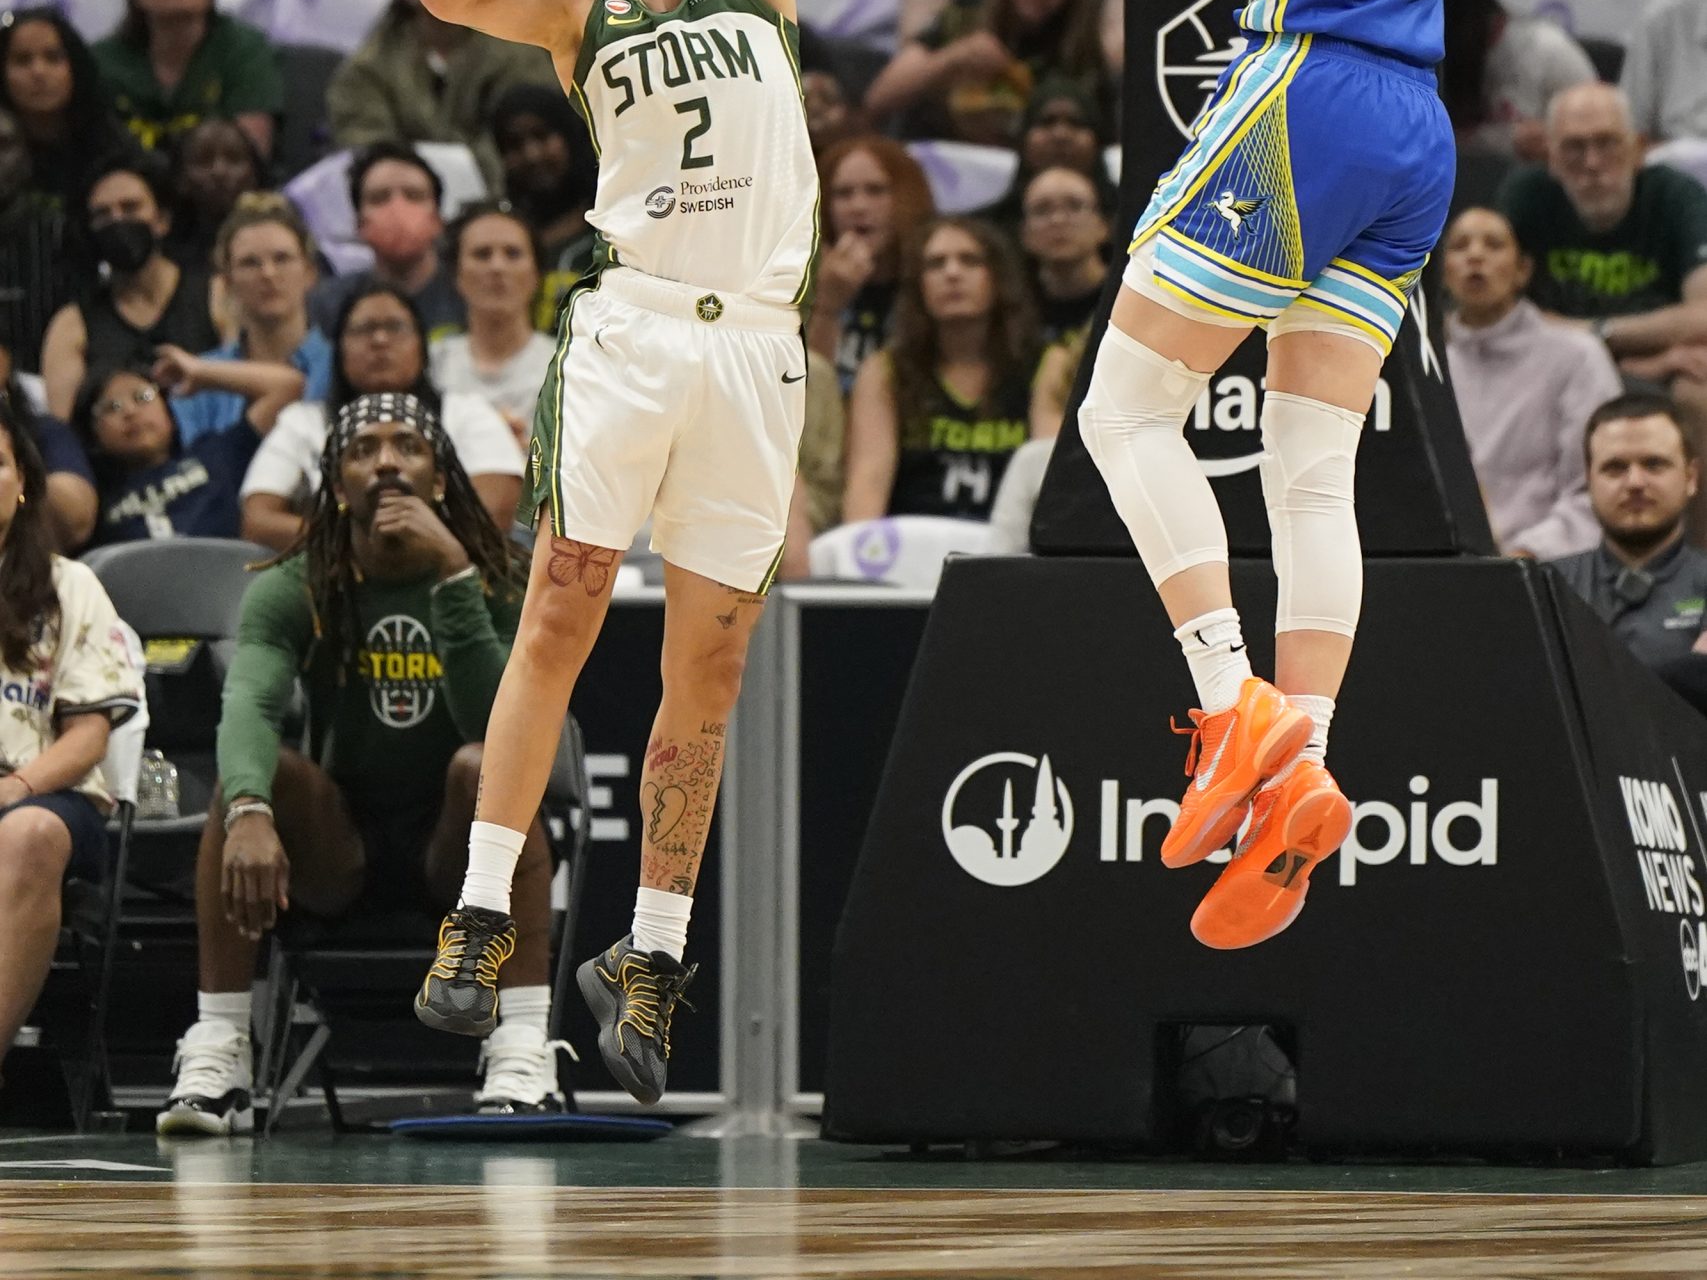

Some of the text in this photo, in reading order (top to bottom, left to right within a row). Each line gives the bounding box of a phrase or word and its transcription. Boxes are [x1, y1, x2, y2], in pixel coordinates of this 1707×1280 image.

[601, 29, 763, 118] STORM
[674, 96, 714, 170] 2
[680, 175, 753, 197] Providence
[680, 196, 734, 214] SWEDISH
[1101, 775, 1499, 887] Inpid
[1619, 775, 1687, 852] KOMO
[1637, 849, 1704, 916] NEWS
